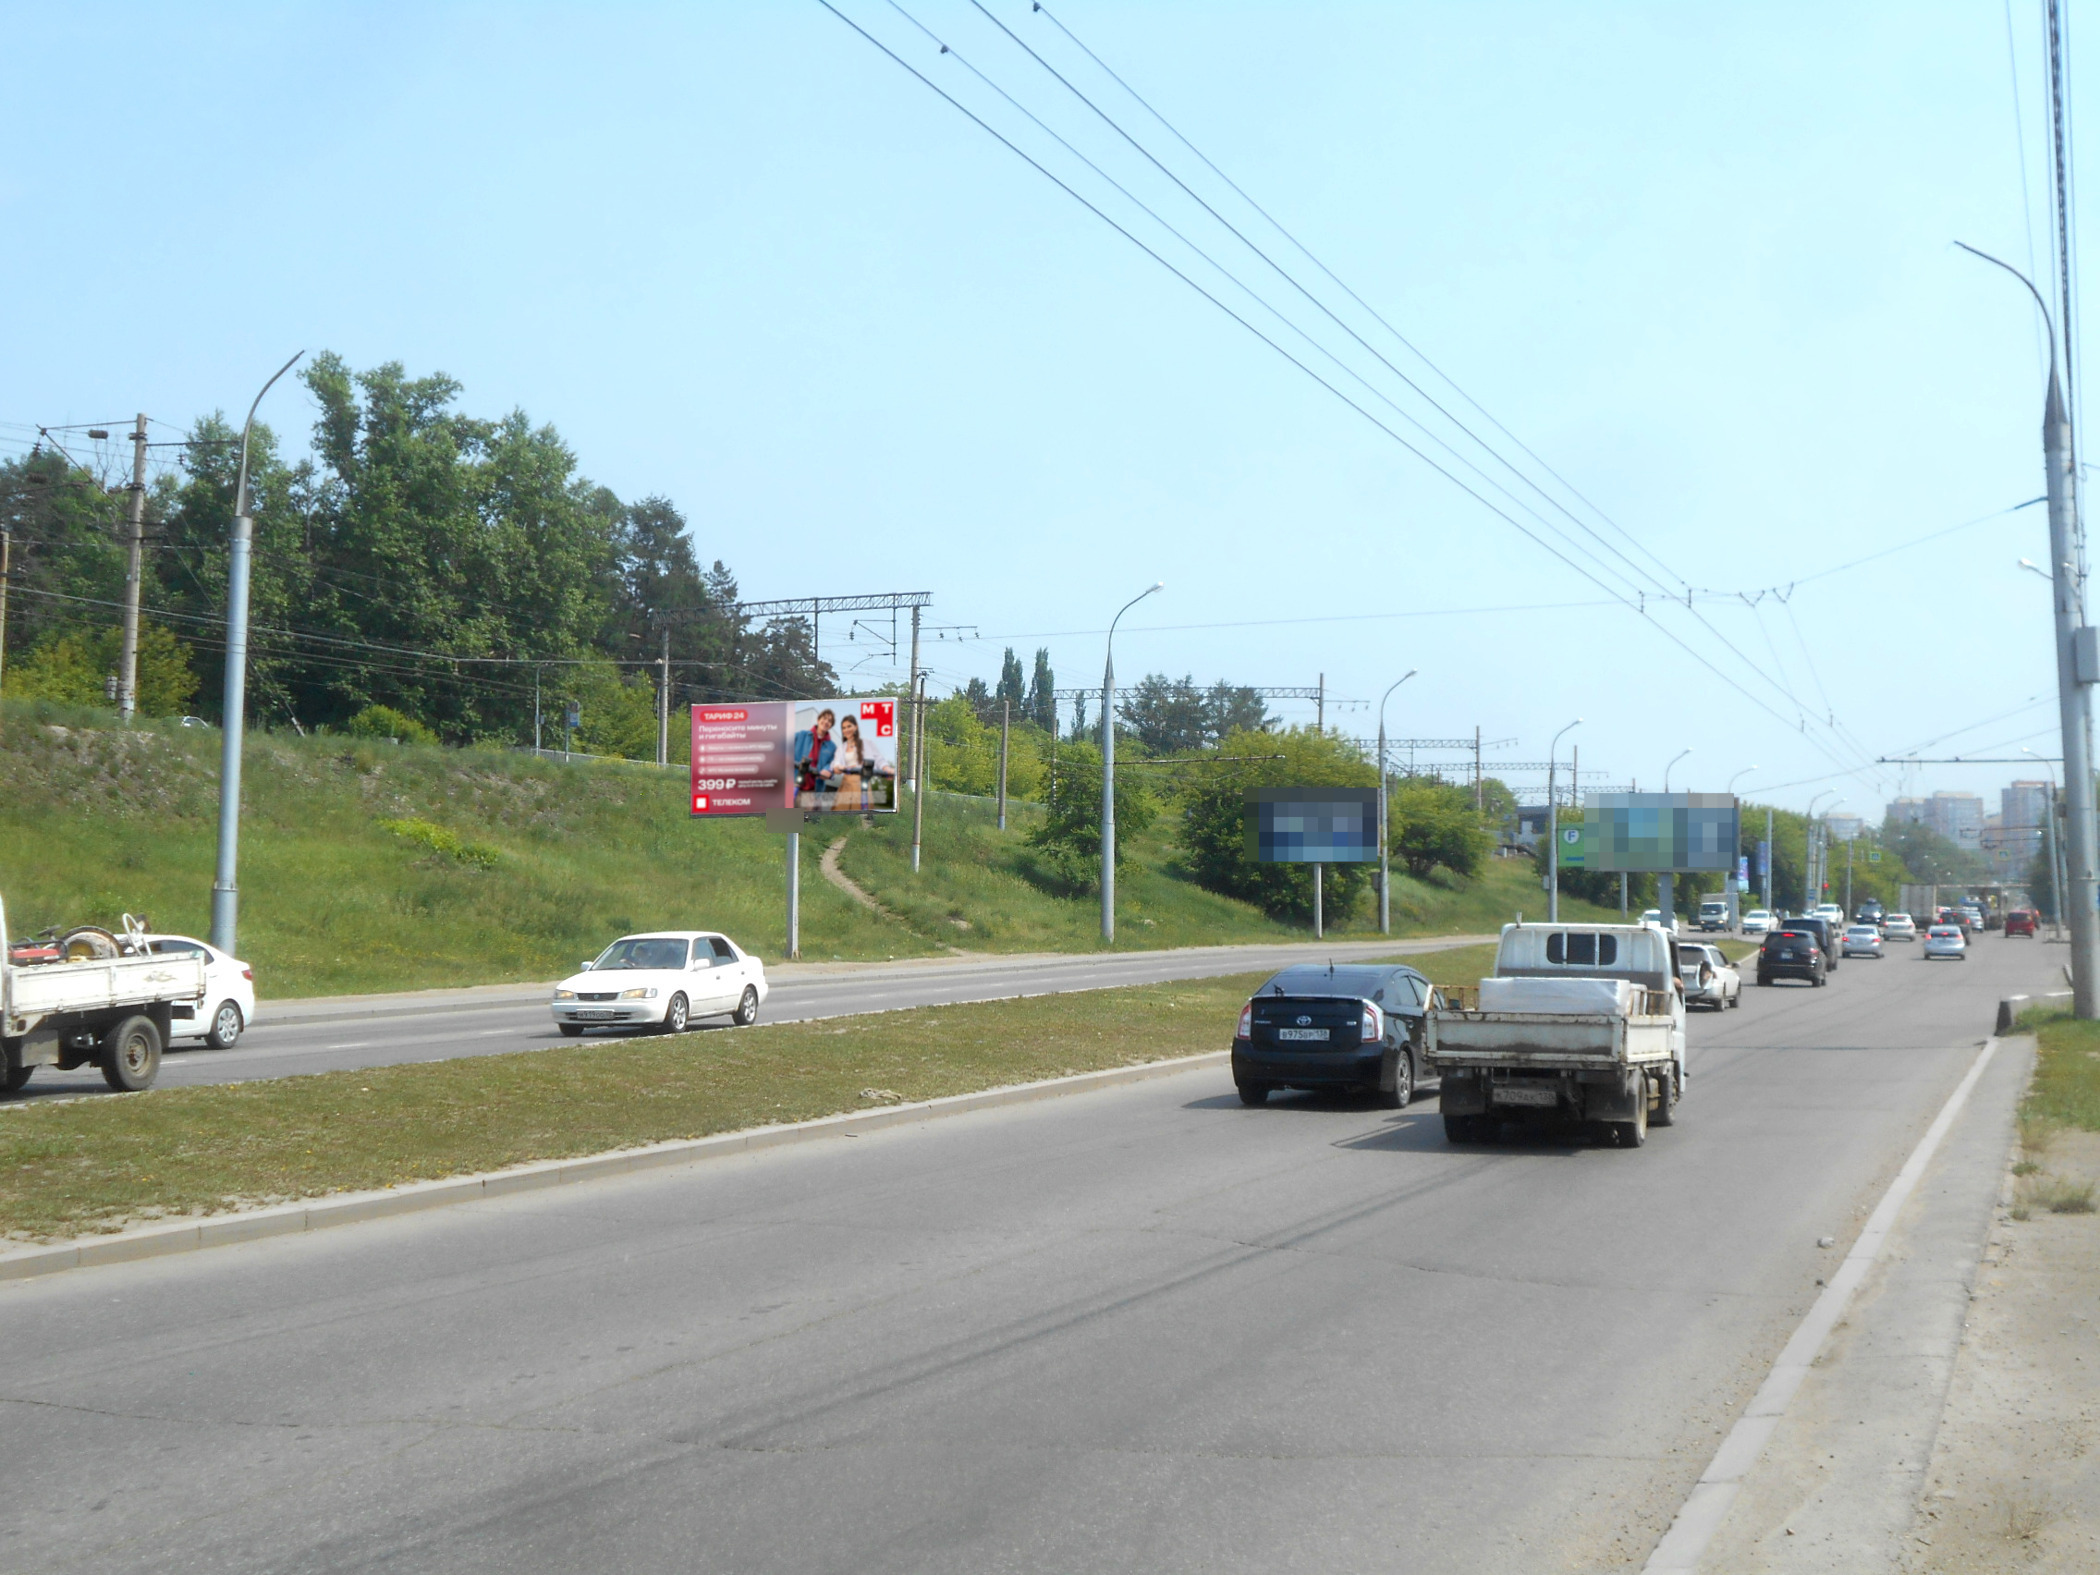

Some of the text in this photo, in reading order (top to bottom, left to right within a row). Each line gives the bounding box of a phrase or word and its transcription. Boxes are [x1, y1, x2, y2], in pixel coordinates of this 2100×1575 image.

[704, 711, 745, 721] ТАРИФ 24
[698, 723, 778, 733] Переносите минуты
[705, 732, 746, 740] гигабайты
[712, 797, 751, 807] ТЕЛЕКОМ
